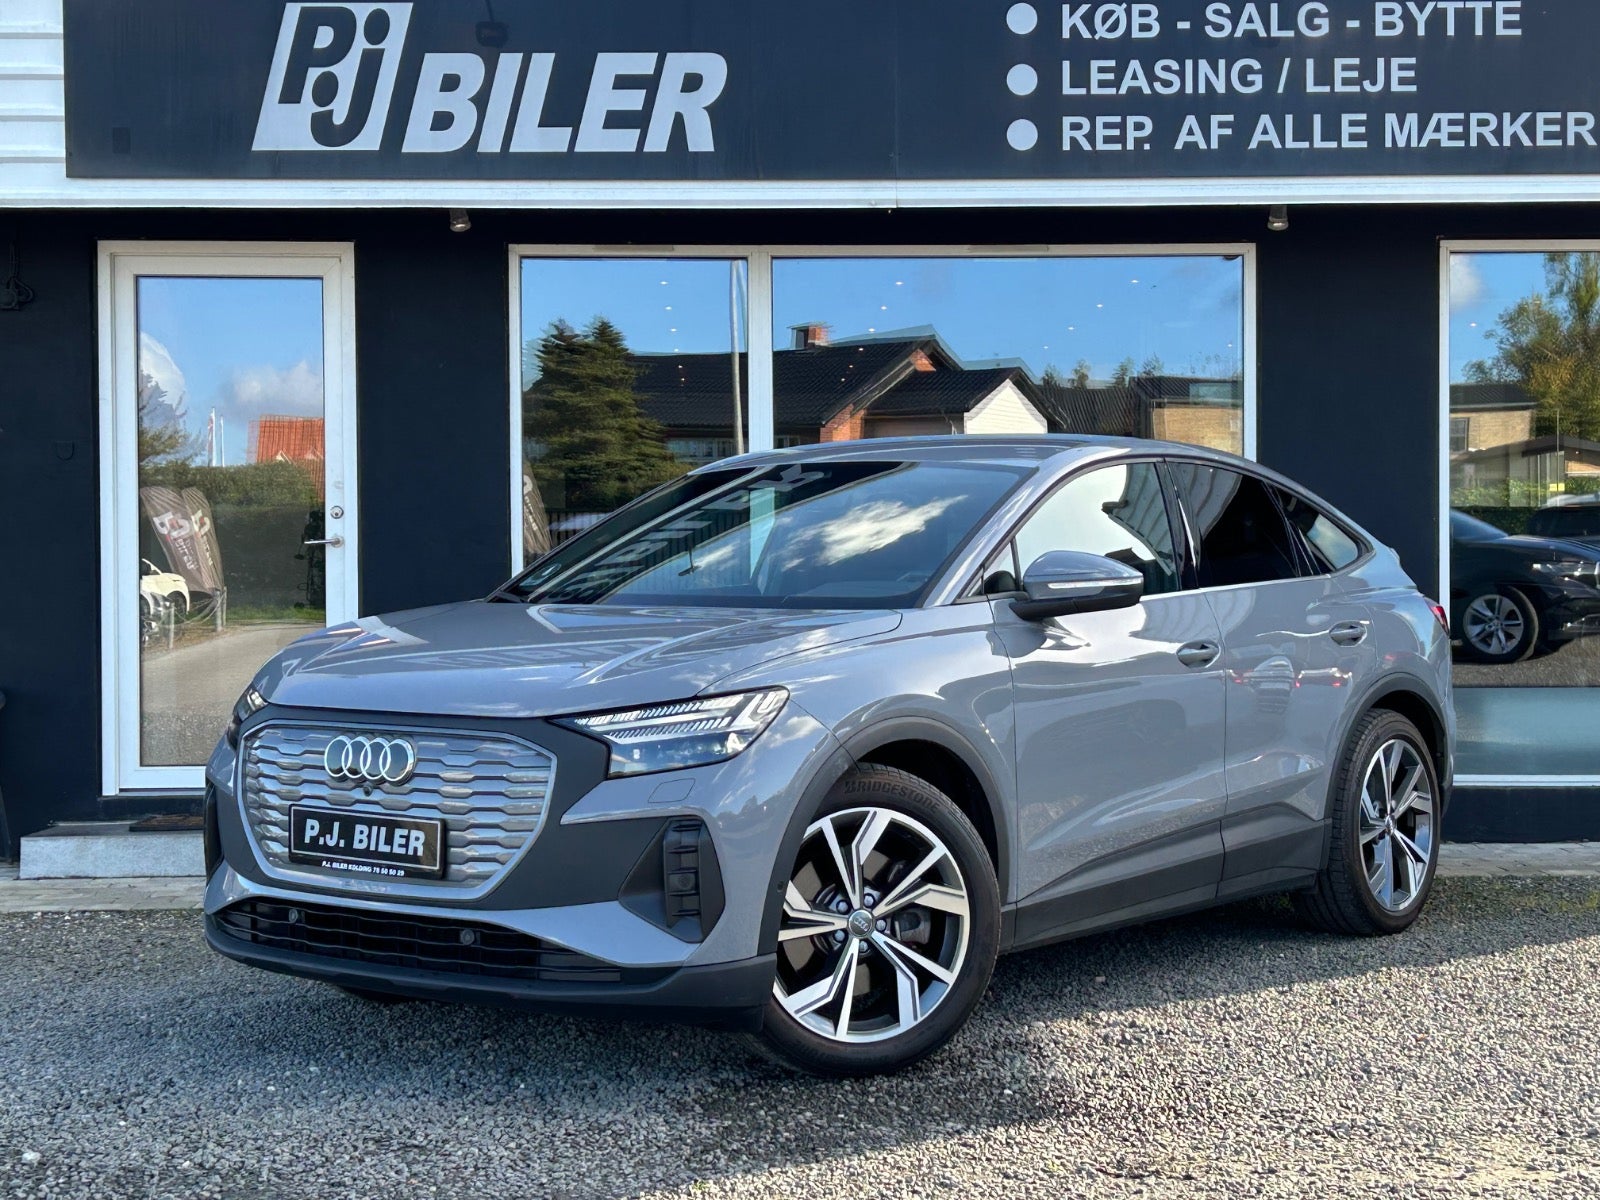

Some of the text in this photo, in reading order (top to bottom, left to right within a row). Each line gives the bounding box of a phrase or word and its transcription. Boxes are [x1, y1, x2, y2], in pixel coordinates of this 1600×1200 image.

[1061, 0, 1522, 41] KØB - SALG - BYTTE
[1061, 56, 1418, 95] LEASING / LEJE
[401, 52, 728, 153] BILER
[1061, 111, 1598, 151] REP. AF ALLE MÆRKER
[844, 779, 940, 814] BRIDGESTONE
[304, 818, 426, 857] P.J. BILER
[333, 862, 347, 870] BILER
[349, 864, 372, 872] KOLDING
